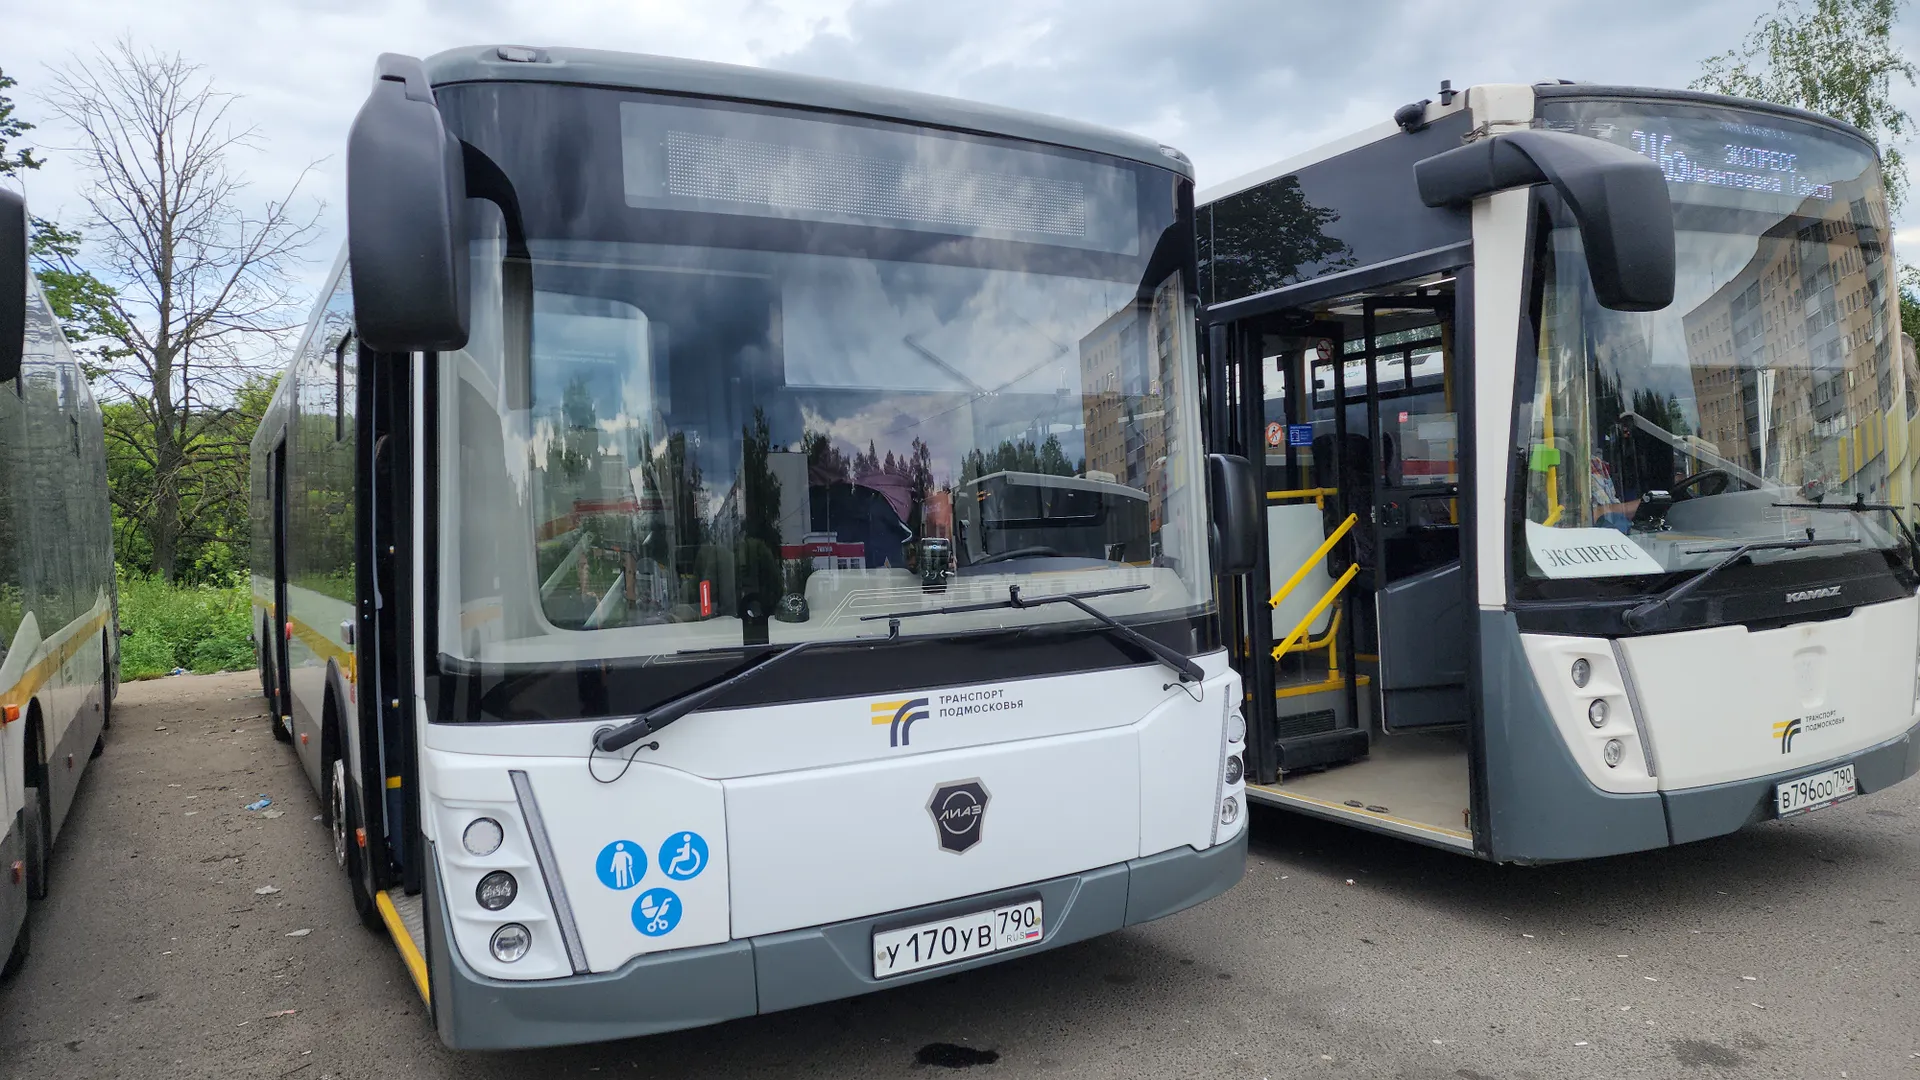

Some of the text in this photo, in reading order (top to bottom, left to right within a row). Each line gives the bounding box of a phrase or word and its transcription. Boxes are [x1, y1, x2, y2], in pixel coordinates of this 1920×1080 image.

[1724, 143, 1797, 173] ЭКСПРЕСС
[1541, 543, 1638, 568] ЭКСПРЕСС
[1785, 585, 1842, 603] KAMAZ
[939, 689, 1004, 705] ТРАНСПОРТ
[939, 700, 1024, 718] ПОДМОСКОВЬЯ
[1805, 709, 1836, 722] ТРАНСПОРТ
[1805, 716, 1845, 731] ПОДМОСКОВЬЯ
[1833, 767, 1852, 788] 790
[939, 805, 982, 821] ЛИАЗ
[886, 906, 1036, 969] У170УВ 790
[1006, 931, 1025, 944] RUS
